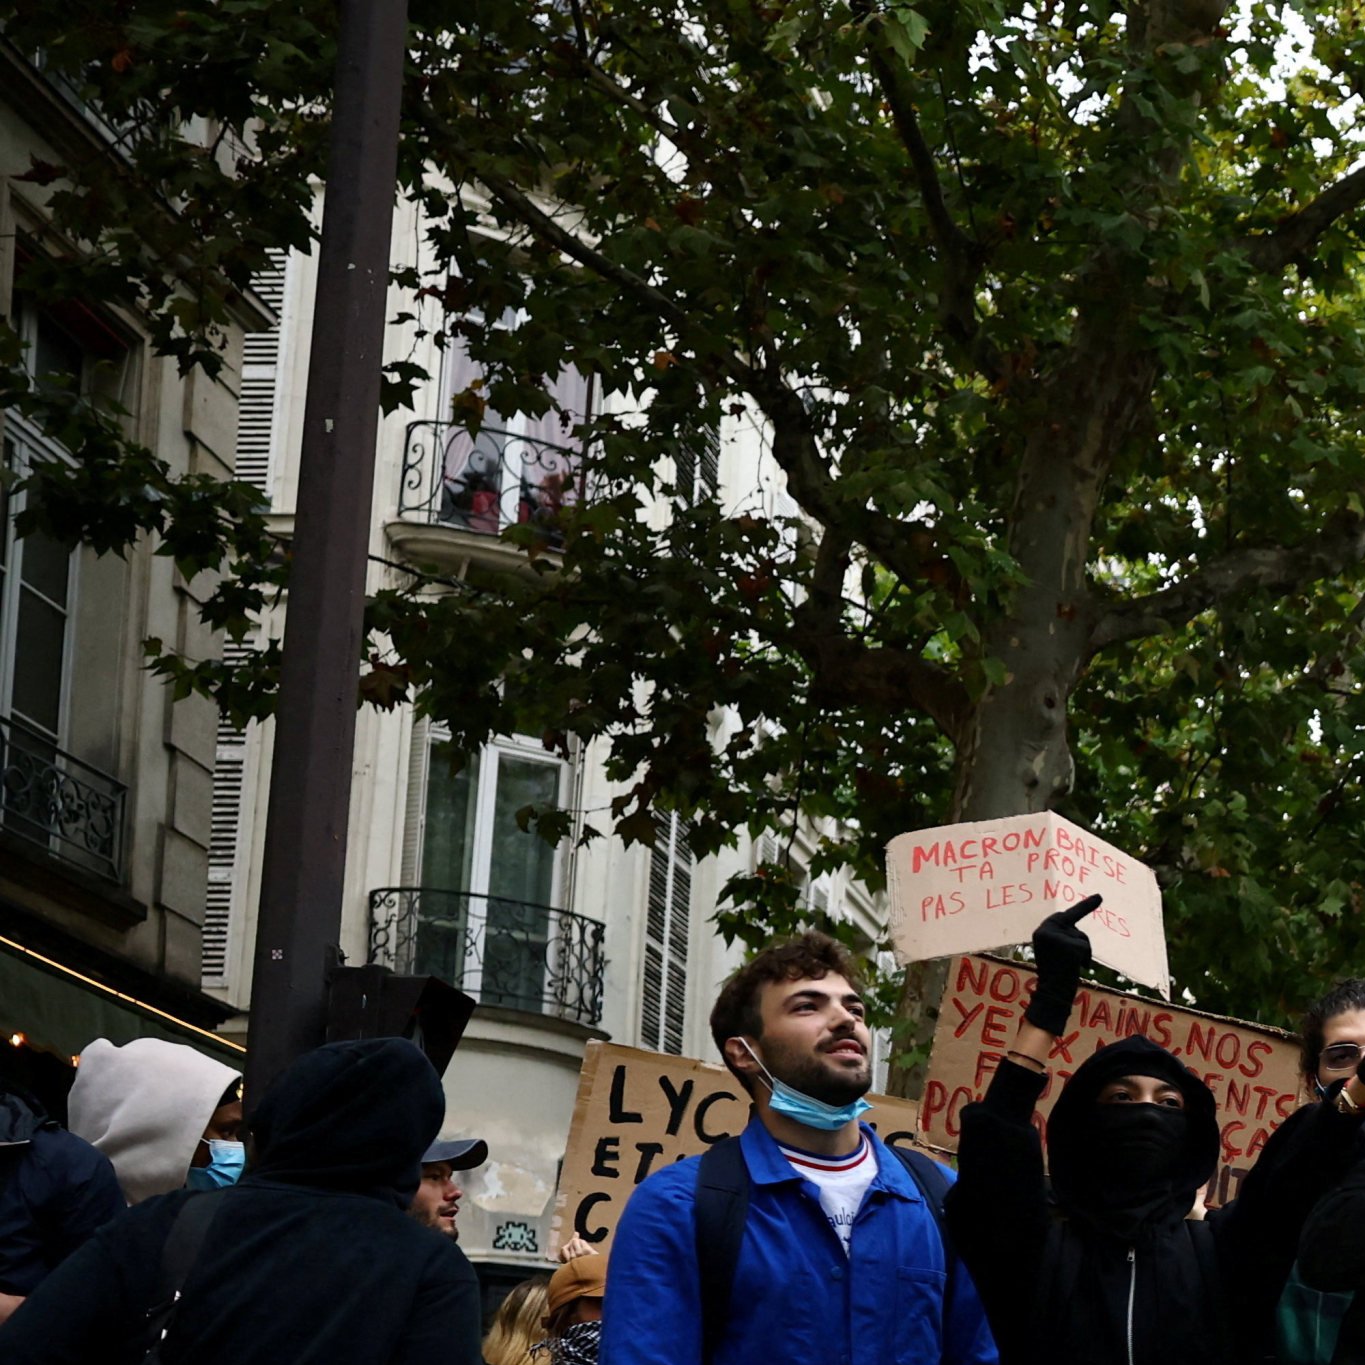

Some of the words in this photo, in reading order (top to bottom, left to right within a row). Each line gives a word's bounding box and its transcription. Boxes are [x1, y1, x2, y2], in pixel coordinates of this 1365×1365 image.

[912, 827, 1047, 874] MACRON
[1056, 827, 1128, 885] BAISE
[949, 861, 994, 883] TA
[1026, 847, 1092, 883] PROF
[921, 891, 966, 922] PAS
[986, 883, 1033, 910] LES
[952, 997, 1080, 1064] YEX
[1186, 1021, 1273, 1078] NOS
